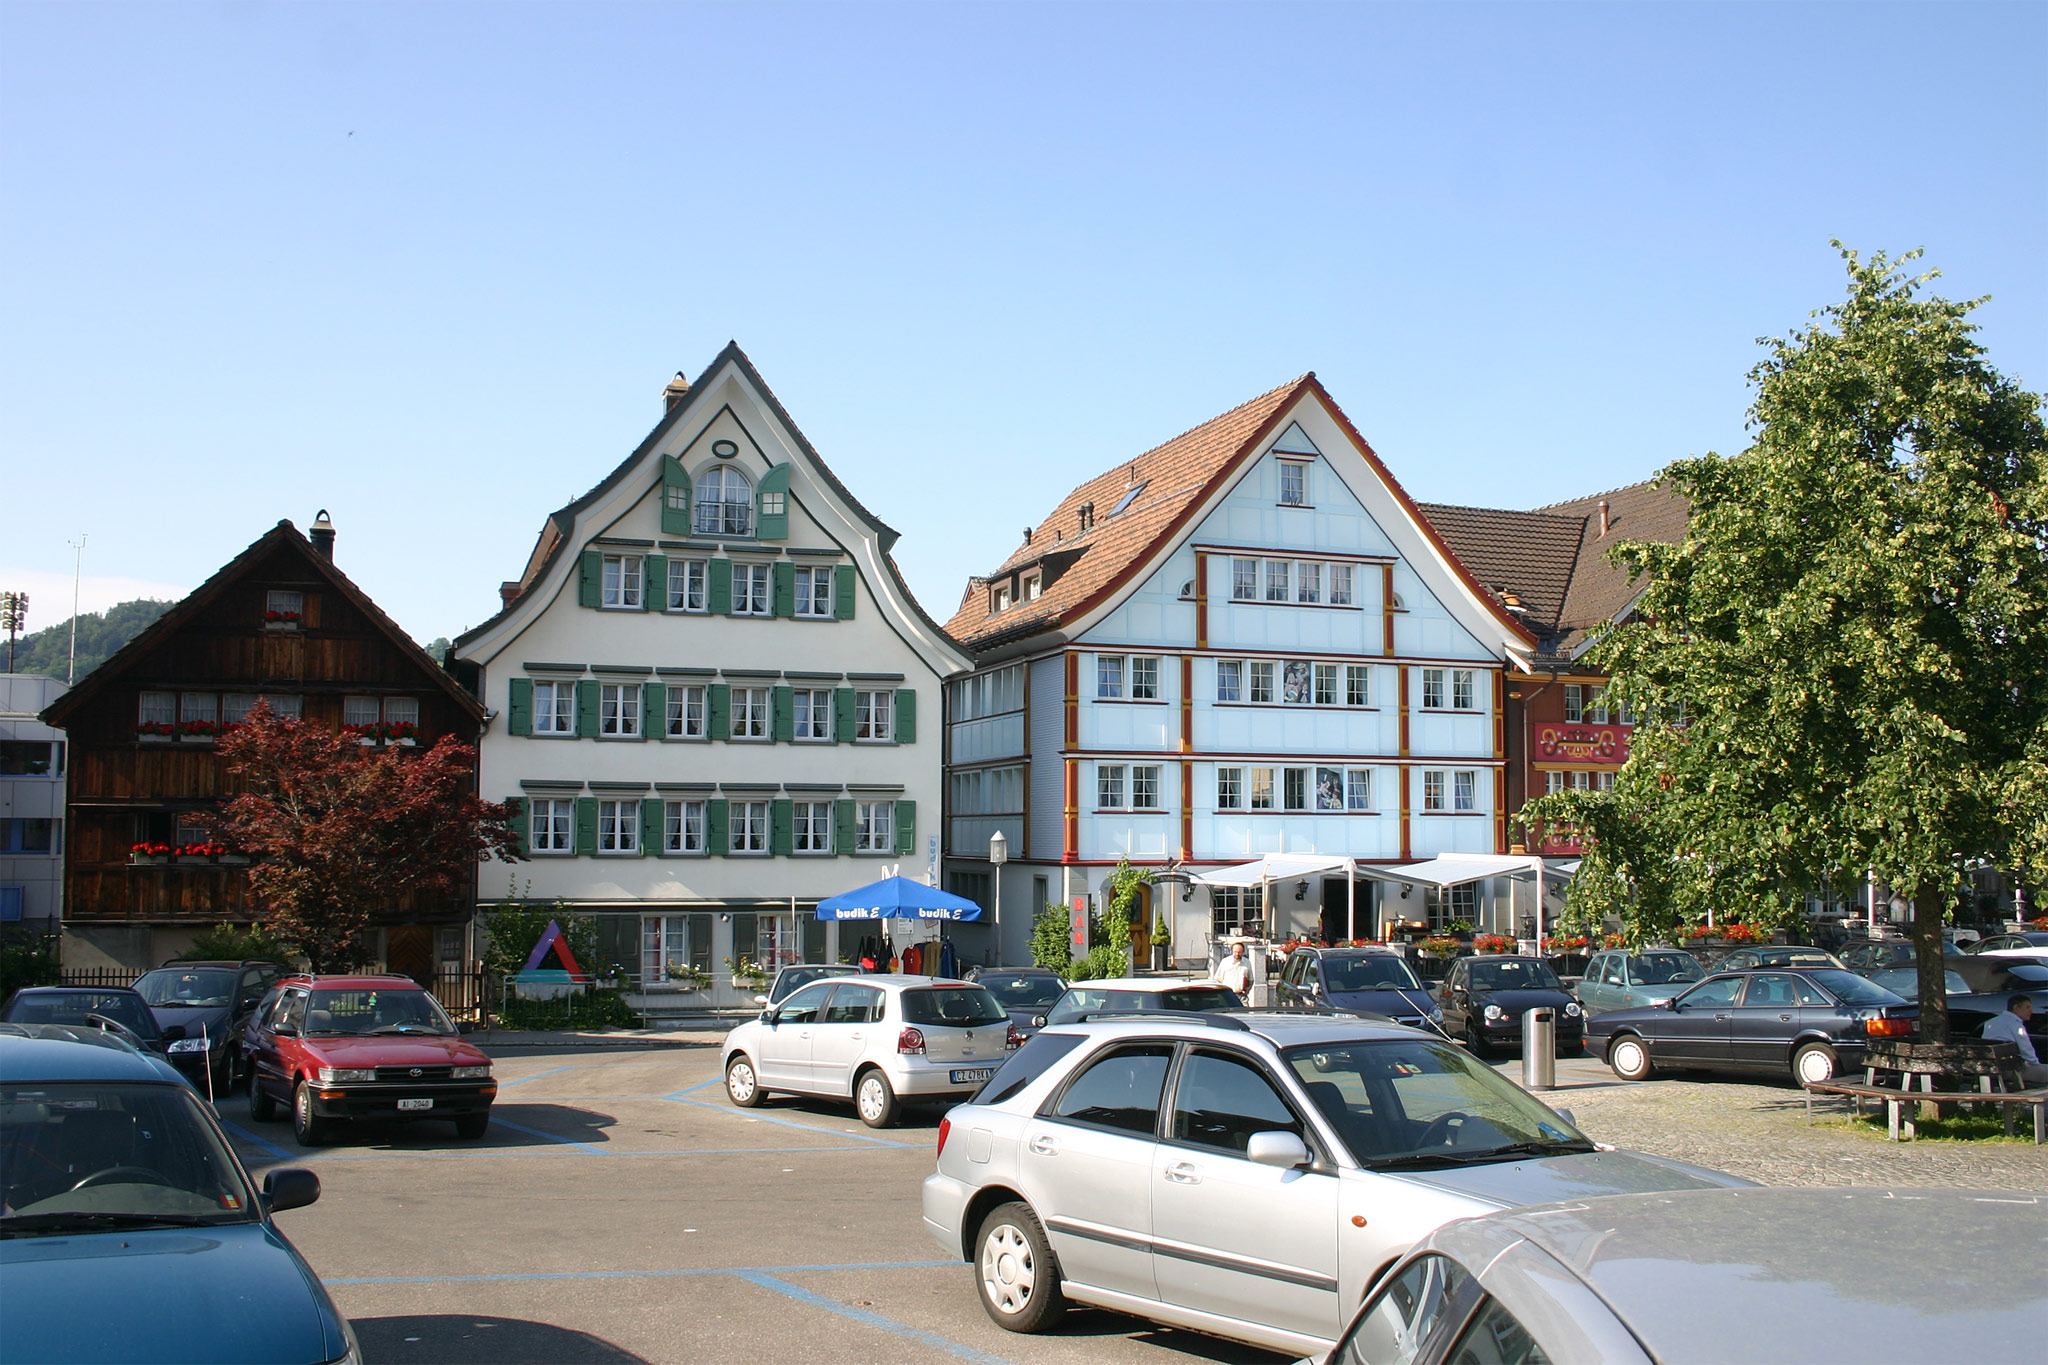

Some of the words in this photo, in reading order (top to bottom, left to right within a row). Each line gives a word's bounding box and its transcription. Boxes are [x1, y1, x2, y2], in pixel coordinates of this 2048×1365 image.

[835, 908, 869, 919] budik
[918, 907, 951, 919] budik
[1073, 897, 1085, 945] BAR
[956, 1070, 966, 1081] CZ
